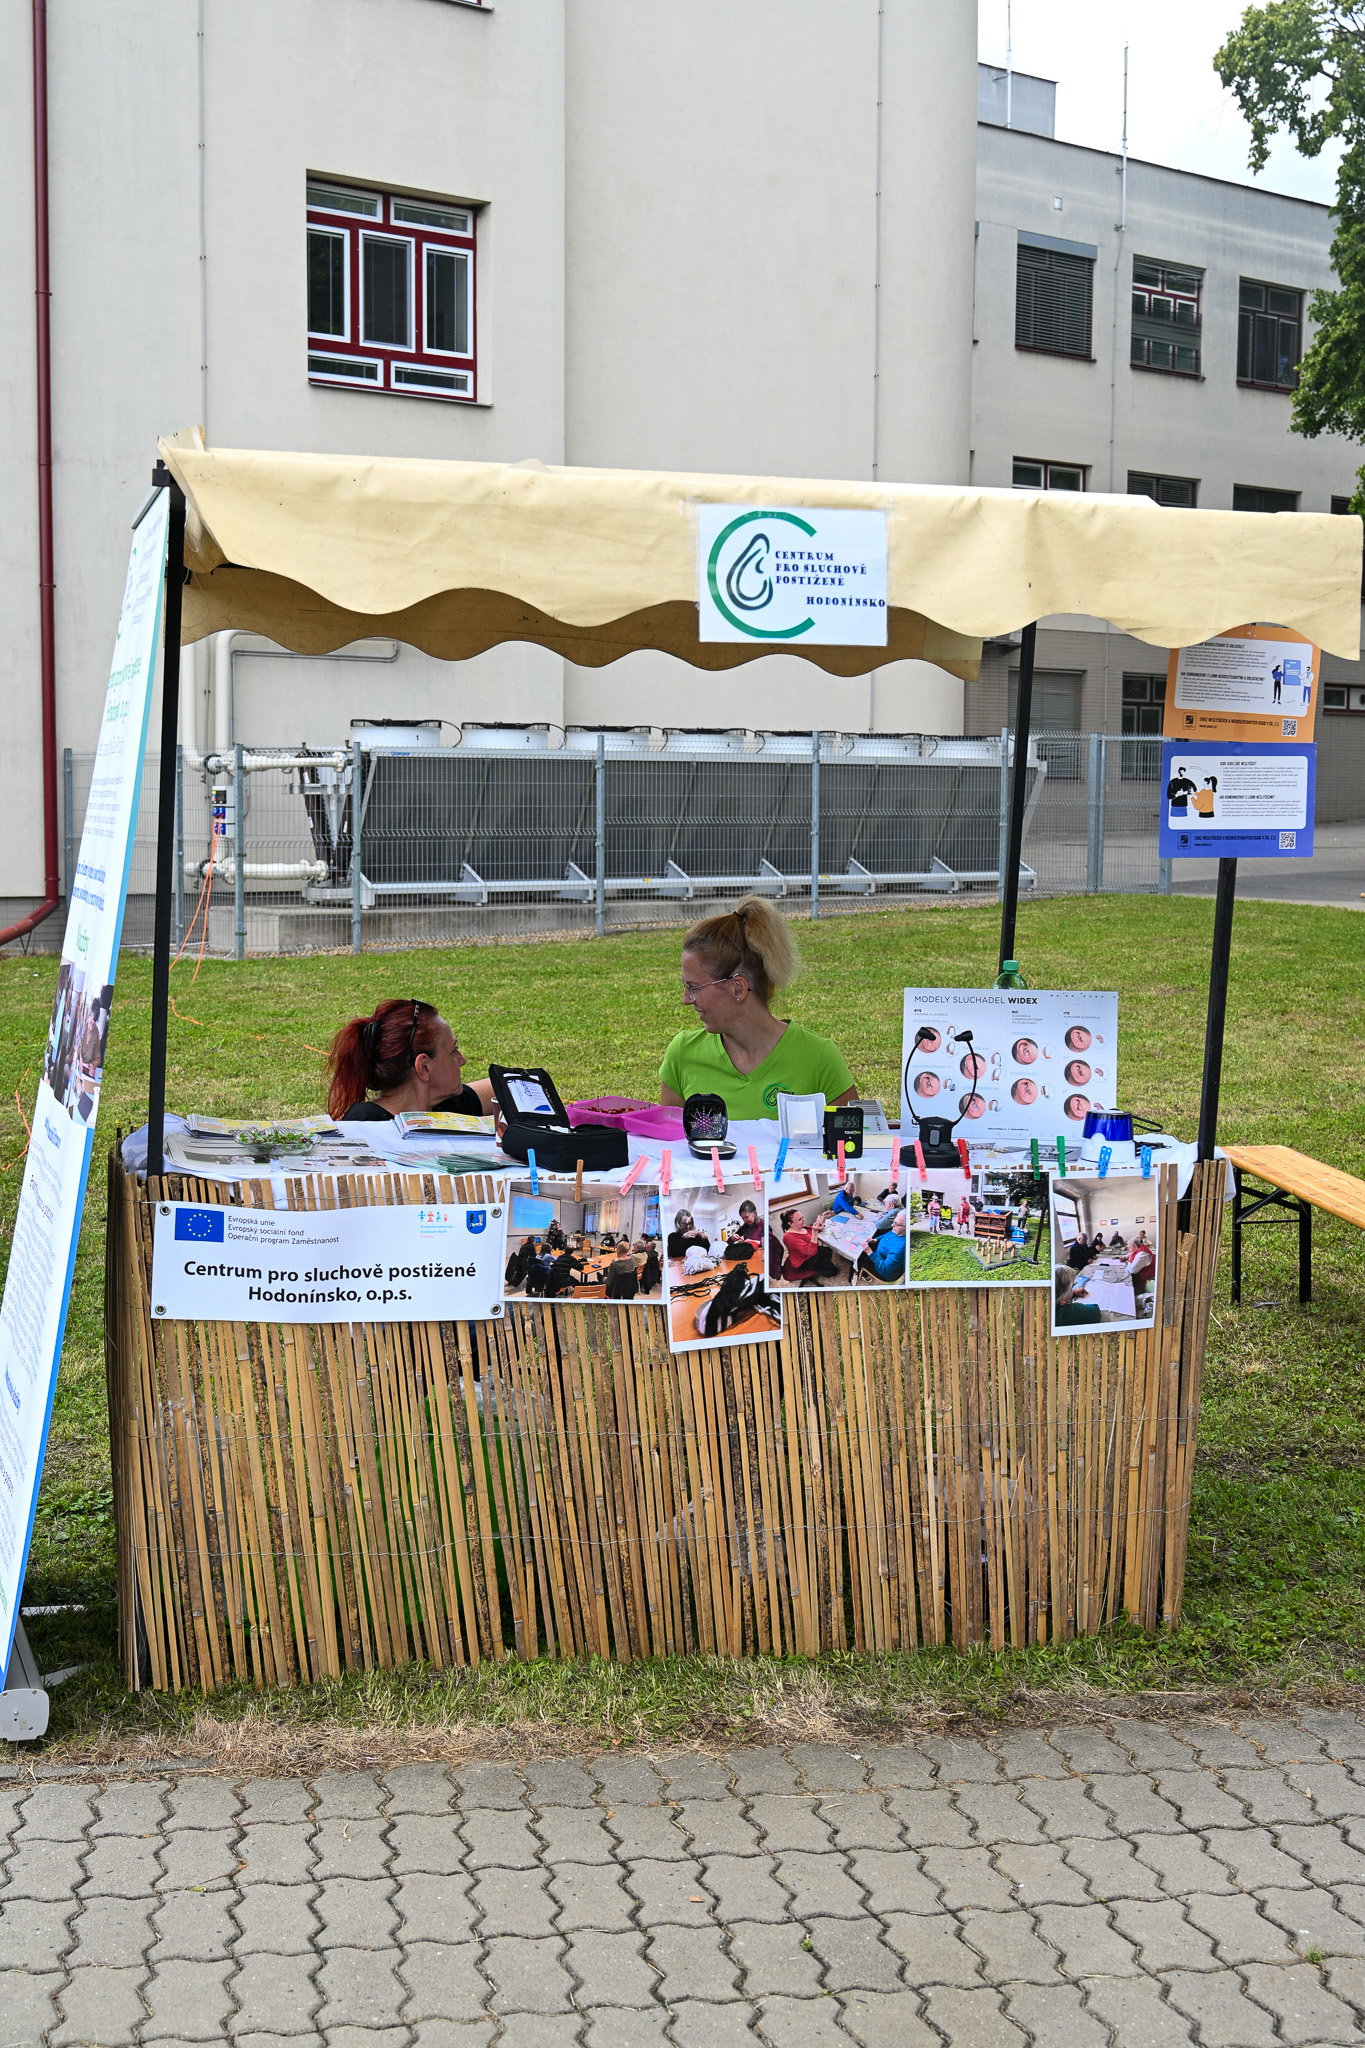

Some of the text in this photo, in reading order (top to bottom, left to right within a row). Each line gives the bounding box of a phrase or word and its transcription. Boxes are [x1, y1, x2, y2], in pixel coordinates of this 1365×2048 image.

[776, 550, 834, 560] CENTRUM
[776, 564, 866, 574] PRO SLUCHOVĚ
[776, 574, 844, 586] POSTIŽENÉ
[806, 595, 886, 607] HODONÍNSKO
[228, 1216, 258, 1225] Evropská
[228, 1224, 258, 1234] Evropský
[260, 1227, 286, 1236] sociální
[228, 1232, 339, 1245] Operační program Zaměstnanost
[184, 1261, 476, 1284] Centrum pro sluchově postižené
[249, 1286, 412, 1304] Hodonínsko, o.p.s.
